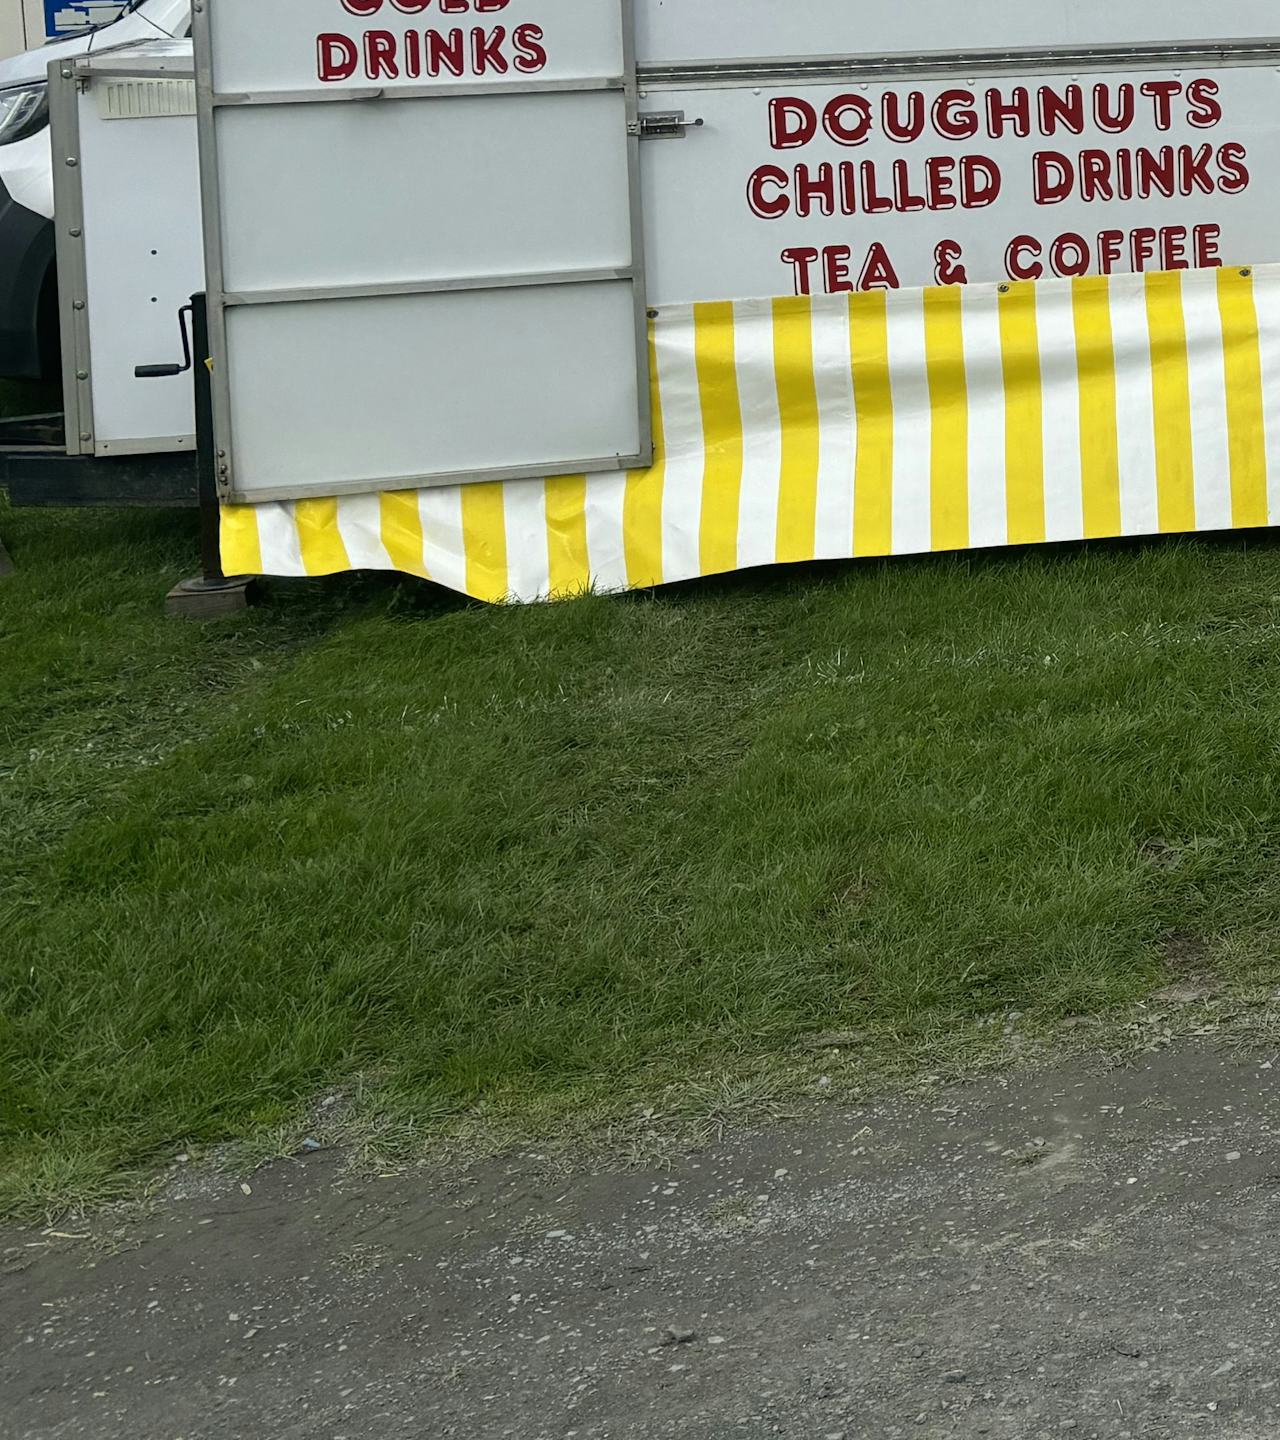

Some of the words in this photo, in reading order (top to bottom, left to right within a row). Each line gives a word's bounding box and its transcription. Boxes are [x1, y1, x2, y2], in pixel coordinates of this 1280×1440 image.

[316, 22, 547, 82] DRINKS
[768, 78, 1223, 150] DOUGHNUTS
[746, 155, 1002, 218] CHILLED
[1032, 141, 1250, 205] DRINKS
[780, 242, 901, 296] TEA
[934, 238, 968, 286] &
[1003, 223, 1223, 281] COFFEE
